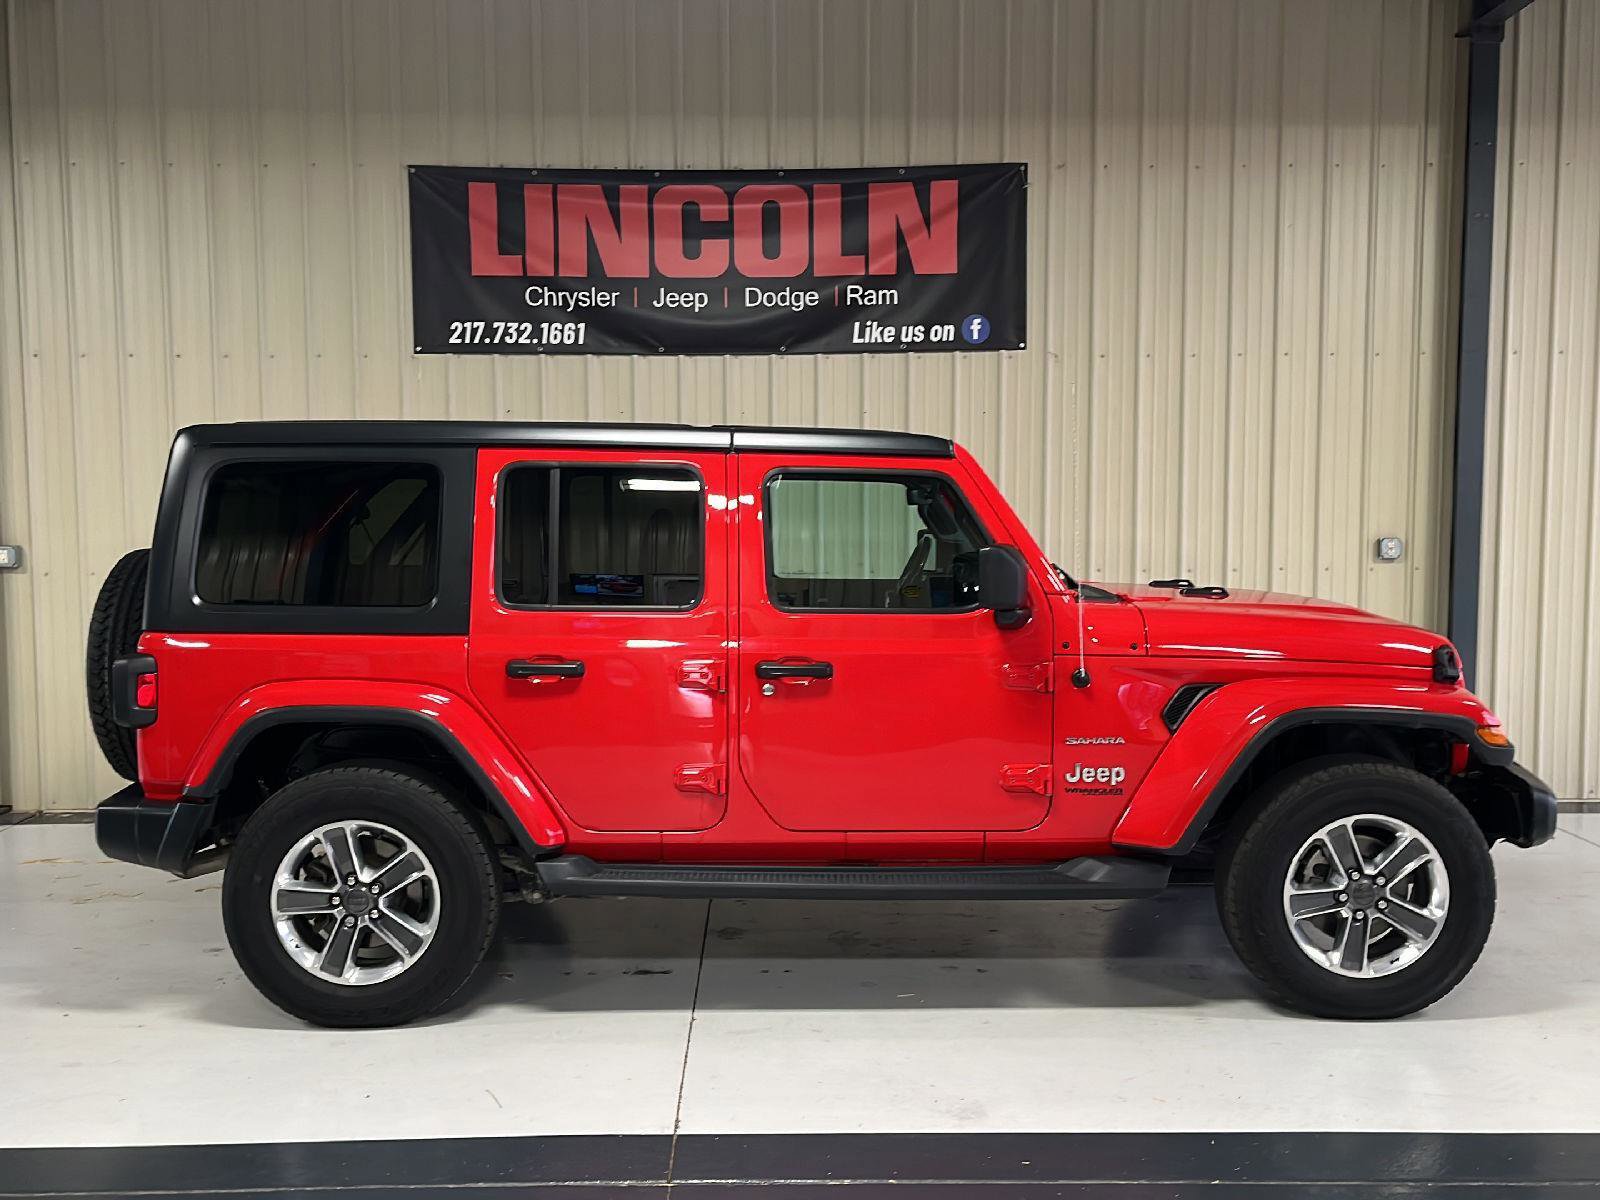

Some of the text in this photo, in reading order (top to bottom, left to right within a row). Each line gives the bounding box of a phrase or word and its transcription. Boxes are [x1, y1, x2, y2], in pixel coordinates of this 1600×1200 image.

[468, 179, 959, 278] LINCOLN
[524, 284, 899, 312] Chrysler Jeep Dodge Ram
[448, 321, 586, 345] 217.732.1661
[852, 320, 896, 344] Like
[900, 324, 925, 343] us
[929, 324, 956, 342] on
[1065, 737, 1125, 745] SAHARA
[1065, 762, 1125, 786] Jeep
